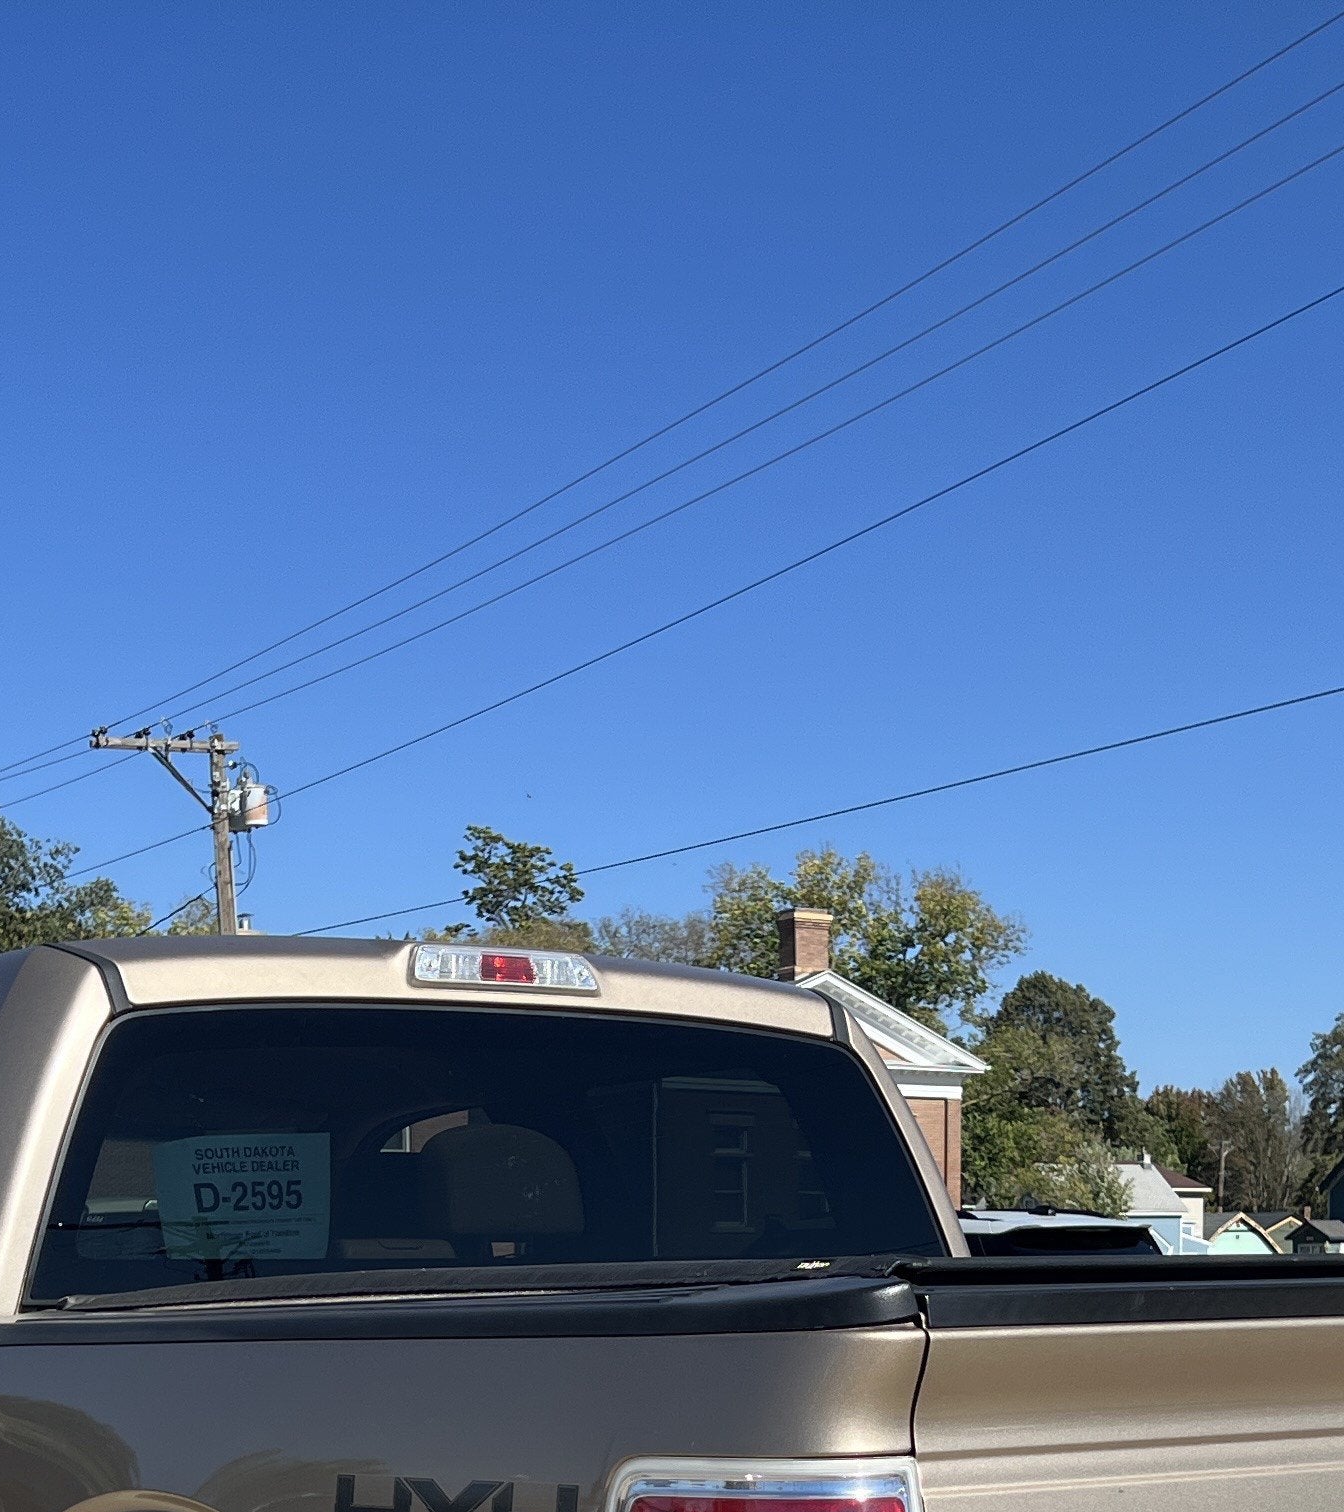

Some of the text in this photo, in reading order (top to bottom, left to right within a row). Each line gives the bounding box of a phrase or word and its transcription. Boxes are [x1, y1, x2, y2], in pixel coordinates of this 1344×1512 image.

[194, 1145, 296, 1161] SOUTH DAKOTA
[192, 1160, 300, 1175] VEHICLE DEALER
[193, 1179, 303, 1213] D-2595
